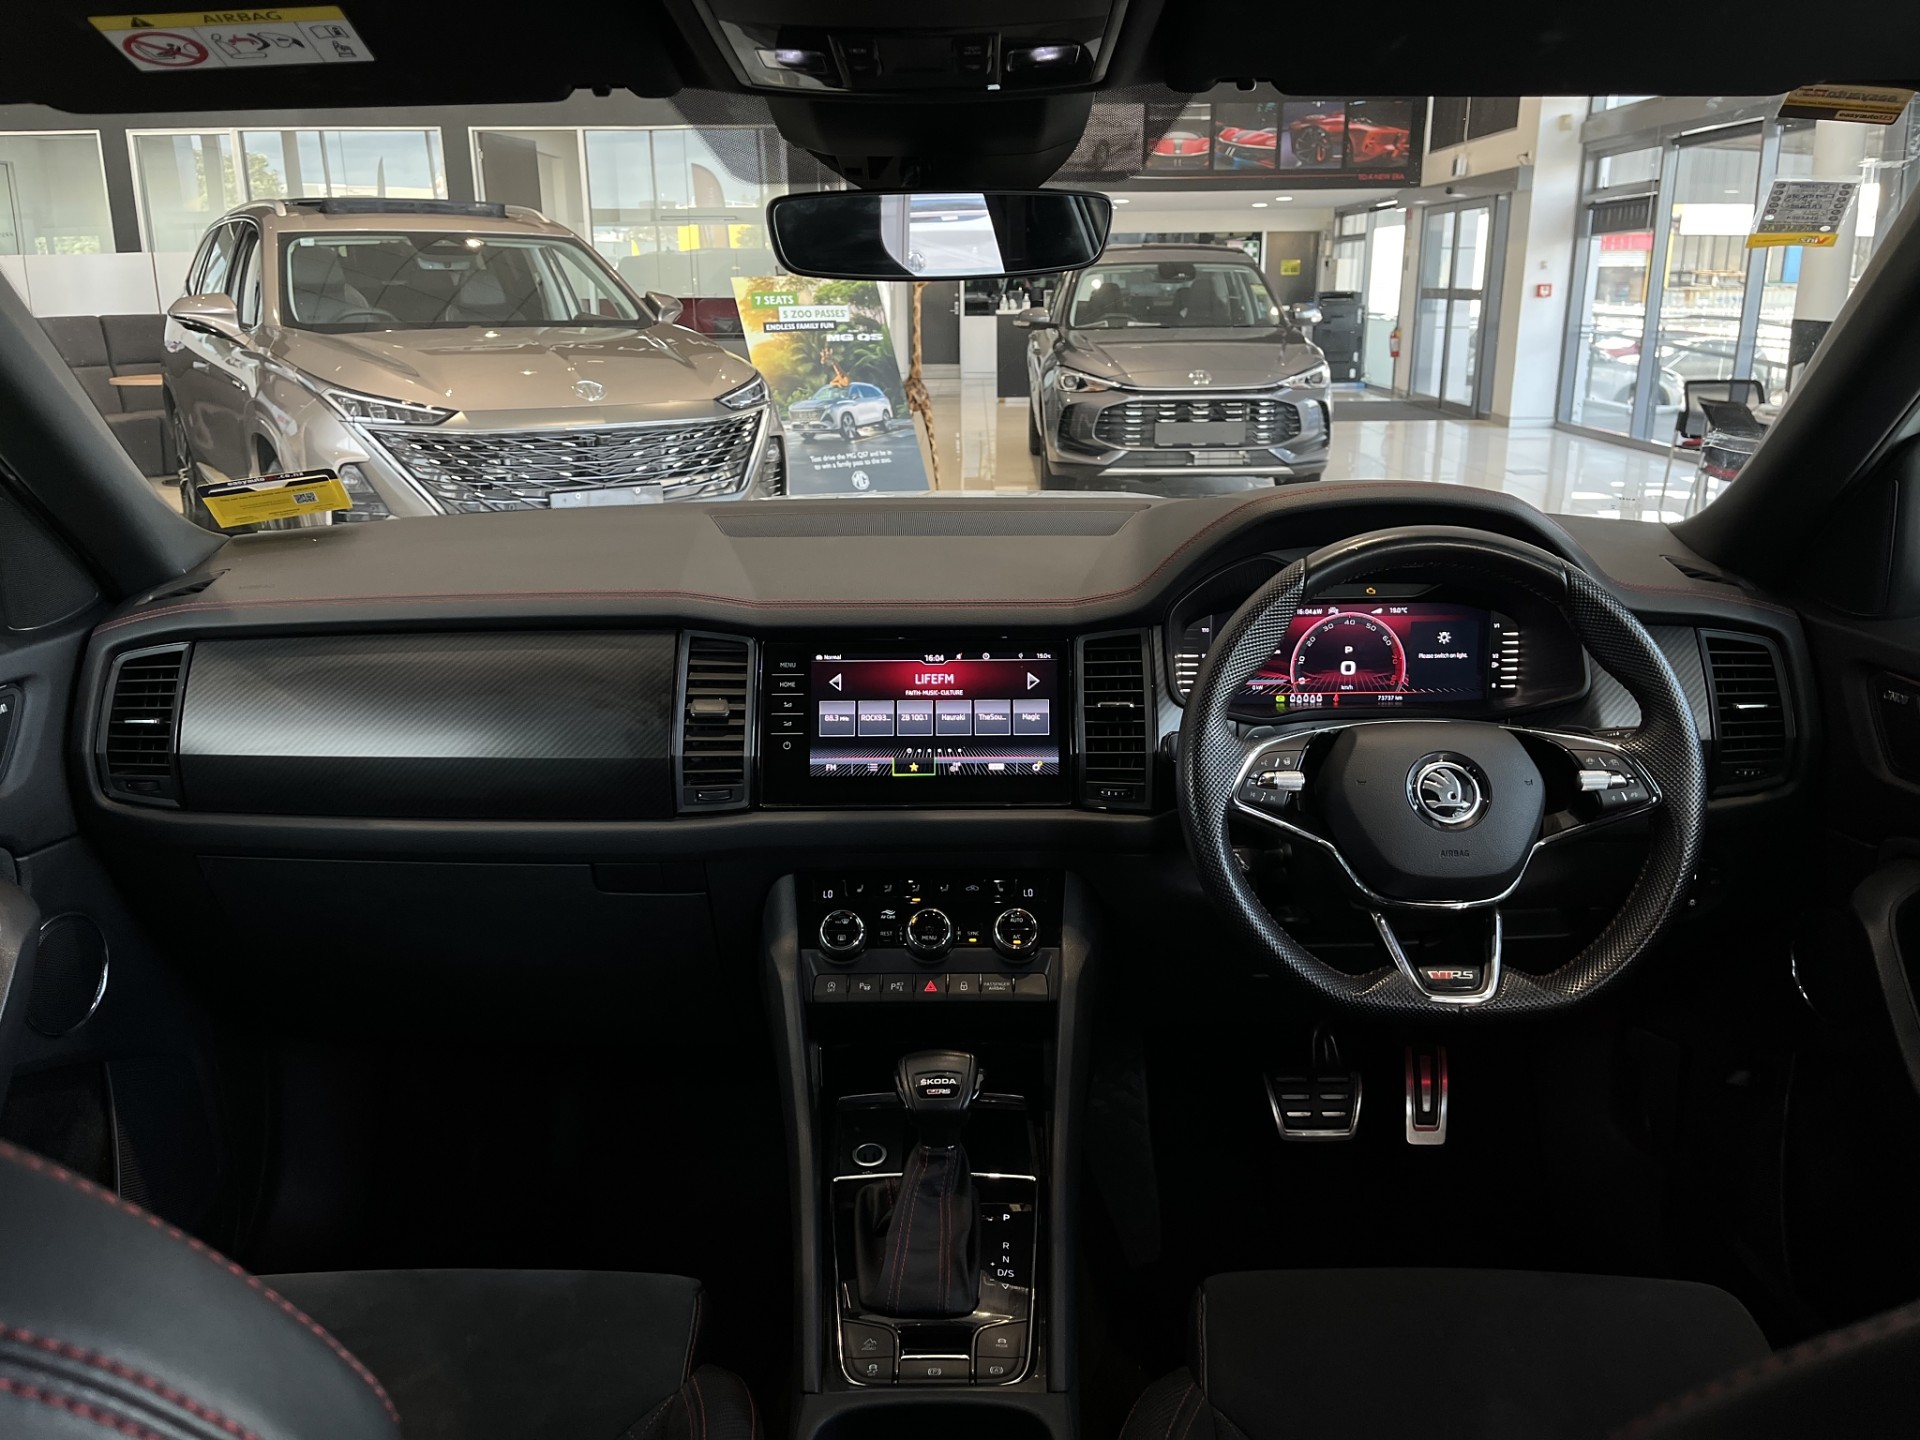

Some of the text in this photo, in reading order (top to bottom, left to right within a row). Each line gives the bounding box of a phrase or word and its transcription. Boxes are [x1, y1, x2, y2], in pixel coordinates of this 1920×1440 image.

[202, 11, 282, 24] AIRBAG
[755, 295, 794, 305] 7 SEATS
[791, 310, 812, 318] ZOO
[765, 323, 795, 331] ENDLESS
[796, 322, 819, 330] FAMILY
[826, 333, 854, 342] MG
[1322, 623, 1334, 632] 30
[1365, 622, 1377, 632] 50
[1306, 636, 1316, 647] 20
[1382, 635, 1392, 646] 60
[1344, 646, 1353, 654] P
[1298, 655, 1305, 664] 10
[1340, 660, 1356, 675] 0
[914, 673, 955, 685] LIFEFM
[941, 713, 966, 721] Hauraki
[1022, 713, 1040, 721] Magic
[825, 763, 837, 771] FM
[997, 1269, 1015, 1277] D/S
